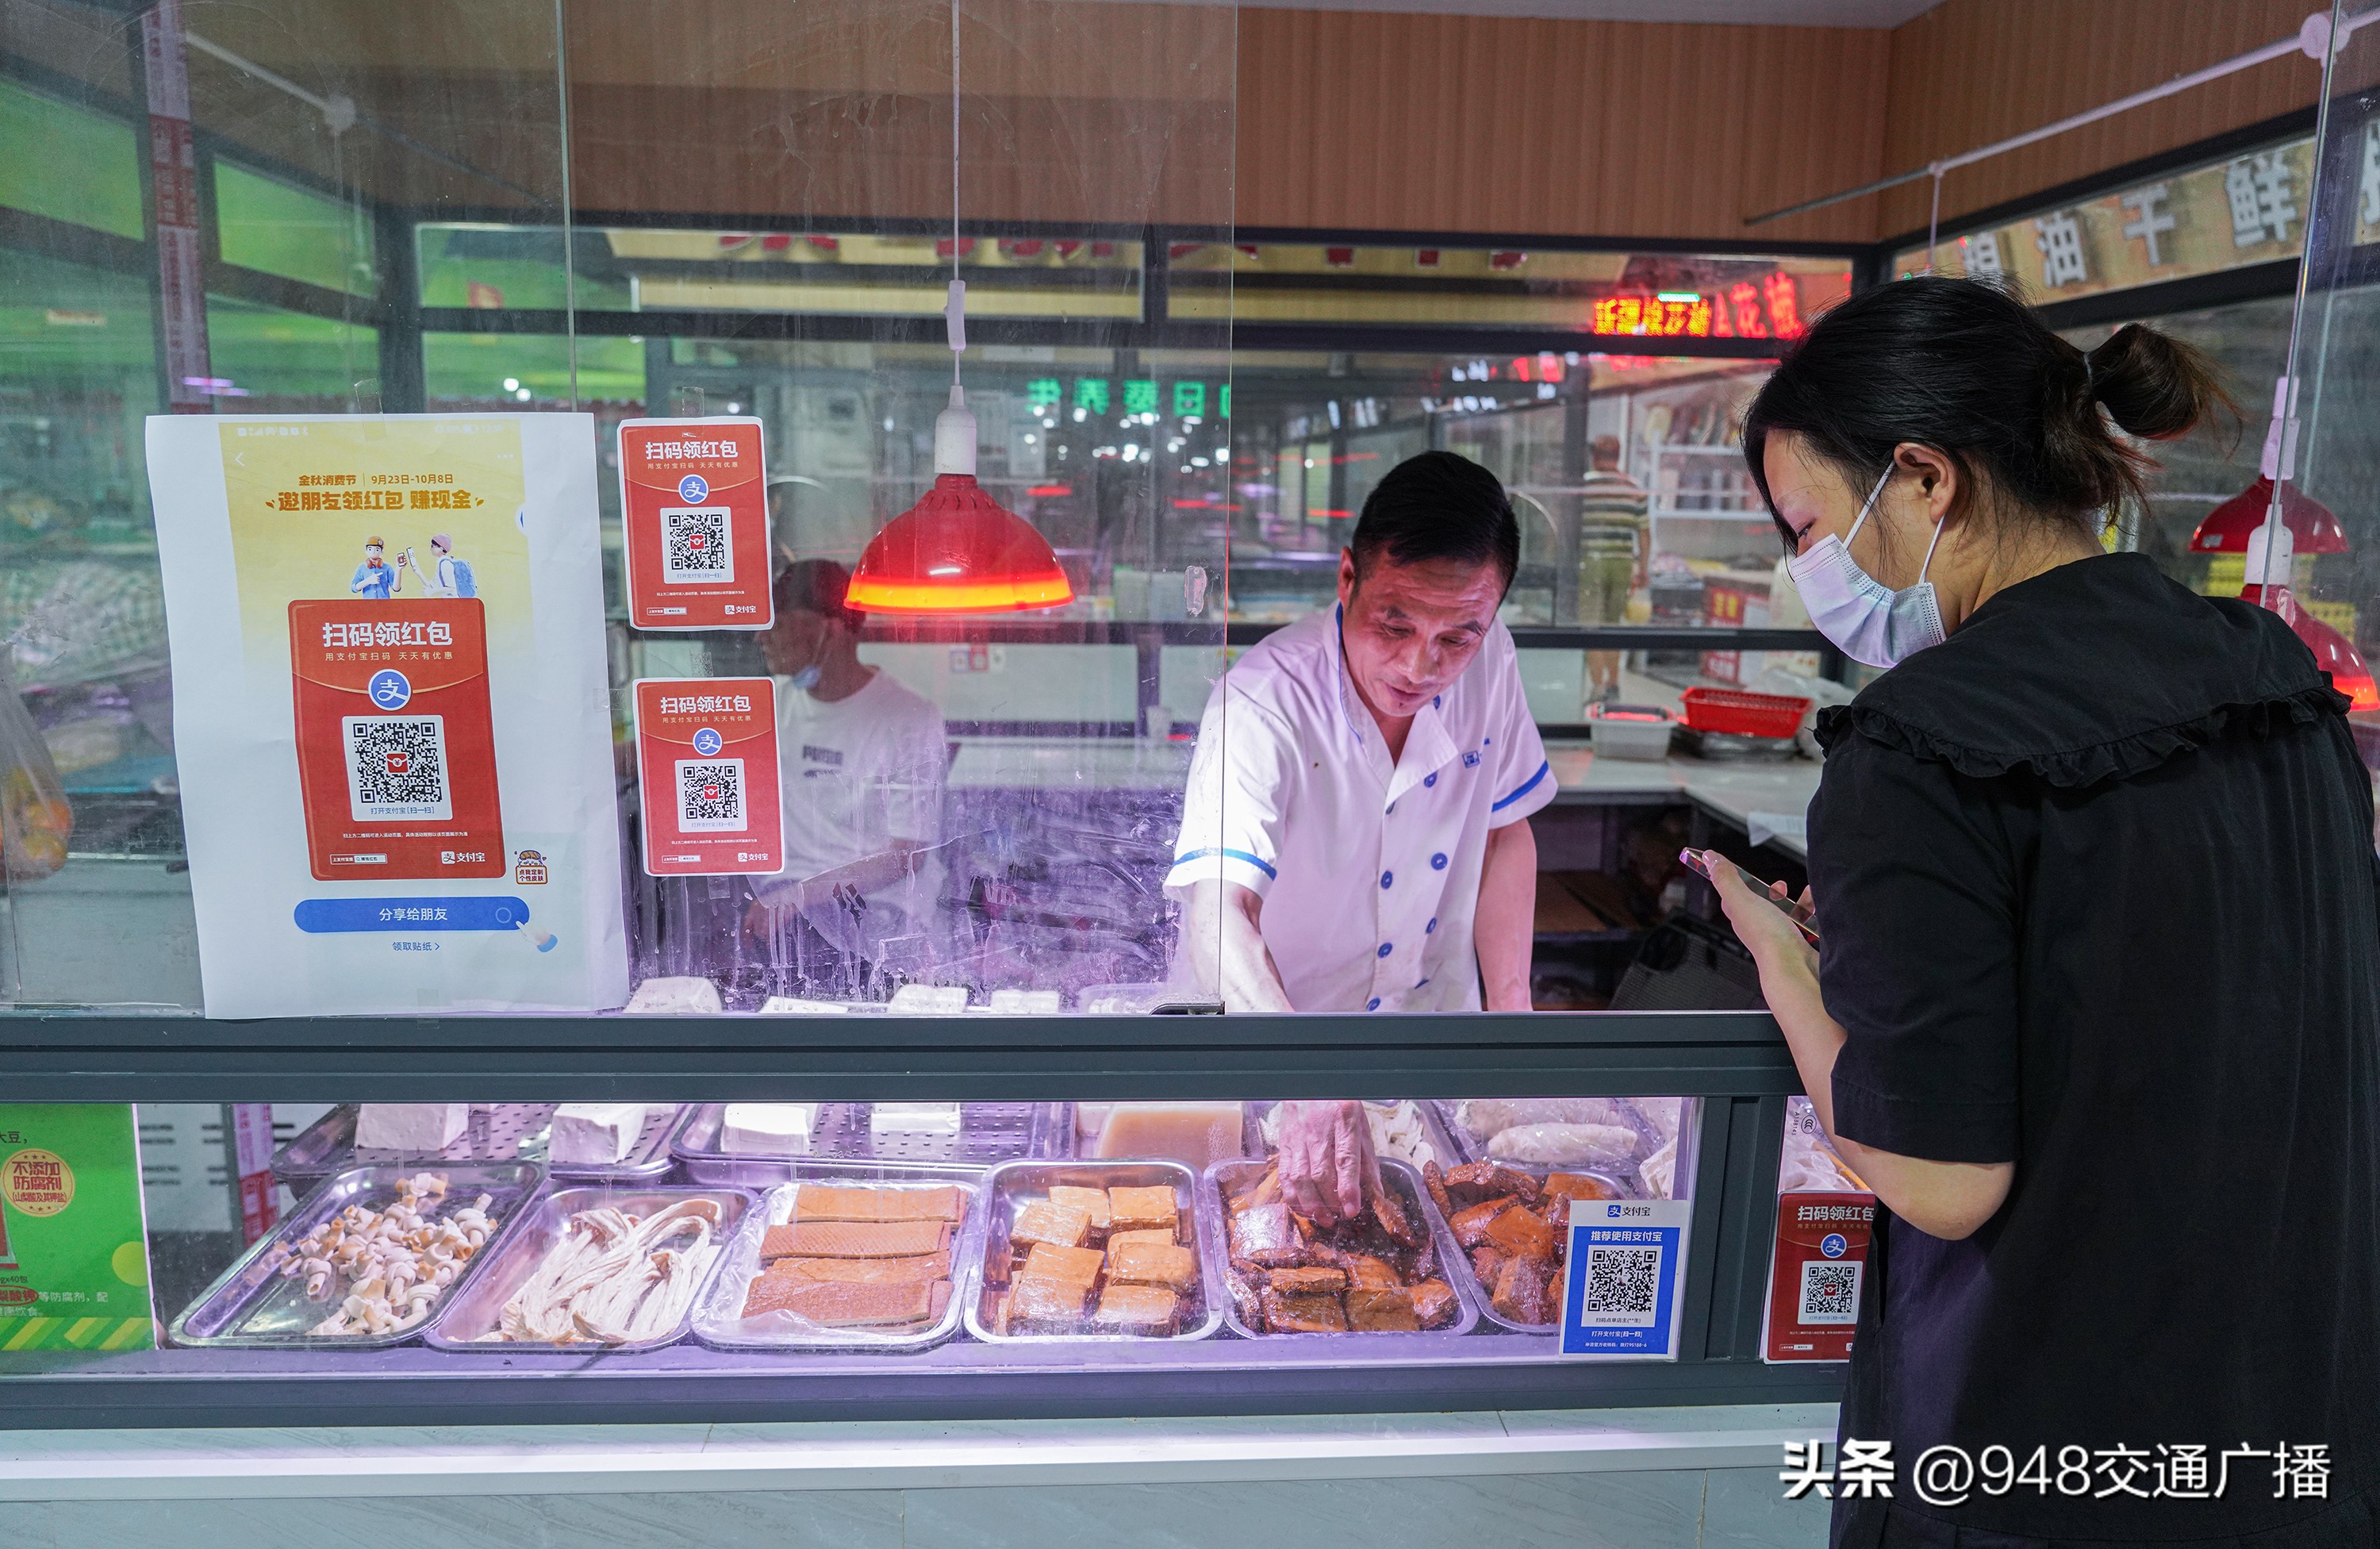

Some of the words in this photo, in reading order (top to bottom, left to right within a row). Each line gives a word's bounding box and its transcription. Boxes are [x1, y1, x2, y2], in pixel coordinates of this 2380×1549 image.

[646, 440, 739, 459] 扫码领红包
[298, 475, 357, 486] 金秋消费节
[370, 474, 454, 485] 9月23日-10月8日
[278, 490, 405, 512] 邀朋友领红包
[410, 490, 472, 510] 赚现金
[322, 621, 453, 648] 扫码领红包
[325, 652, 391, 661] 用支付宝扫码
[398, 652, 453, 660] 天天有优惠
[660, 695, 751, 714] 扫码领红包
[456, 851, 486, 863] 支付宝
[378, 908, 448, 922] 分享给朋友
[392, 941, 432, 952] 领取贴纸
[12, 1161, 61, 1176] 不添加
[13, 1175, 63, 1190] 防腐剂
[1622, 1206, 1651, 1217] 支付宝
[1797, 1205, 1875, 1221] 扫码领红包
[1591, 1231, 1663, 1242] 推荐使用支付宝
